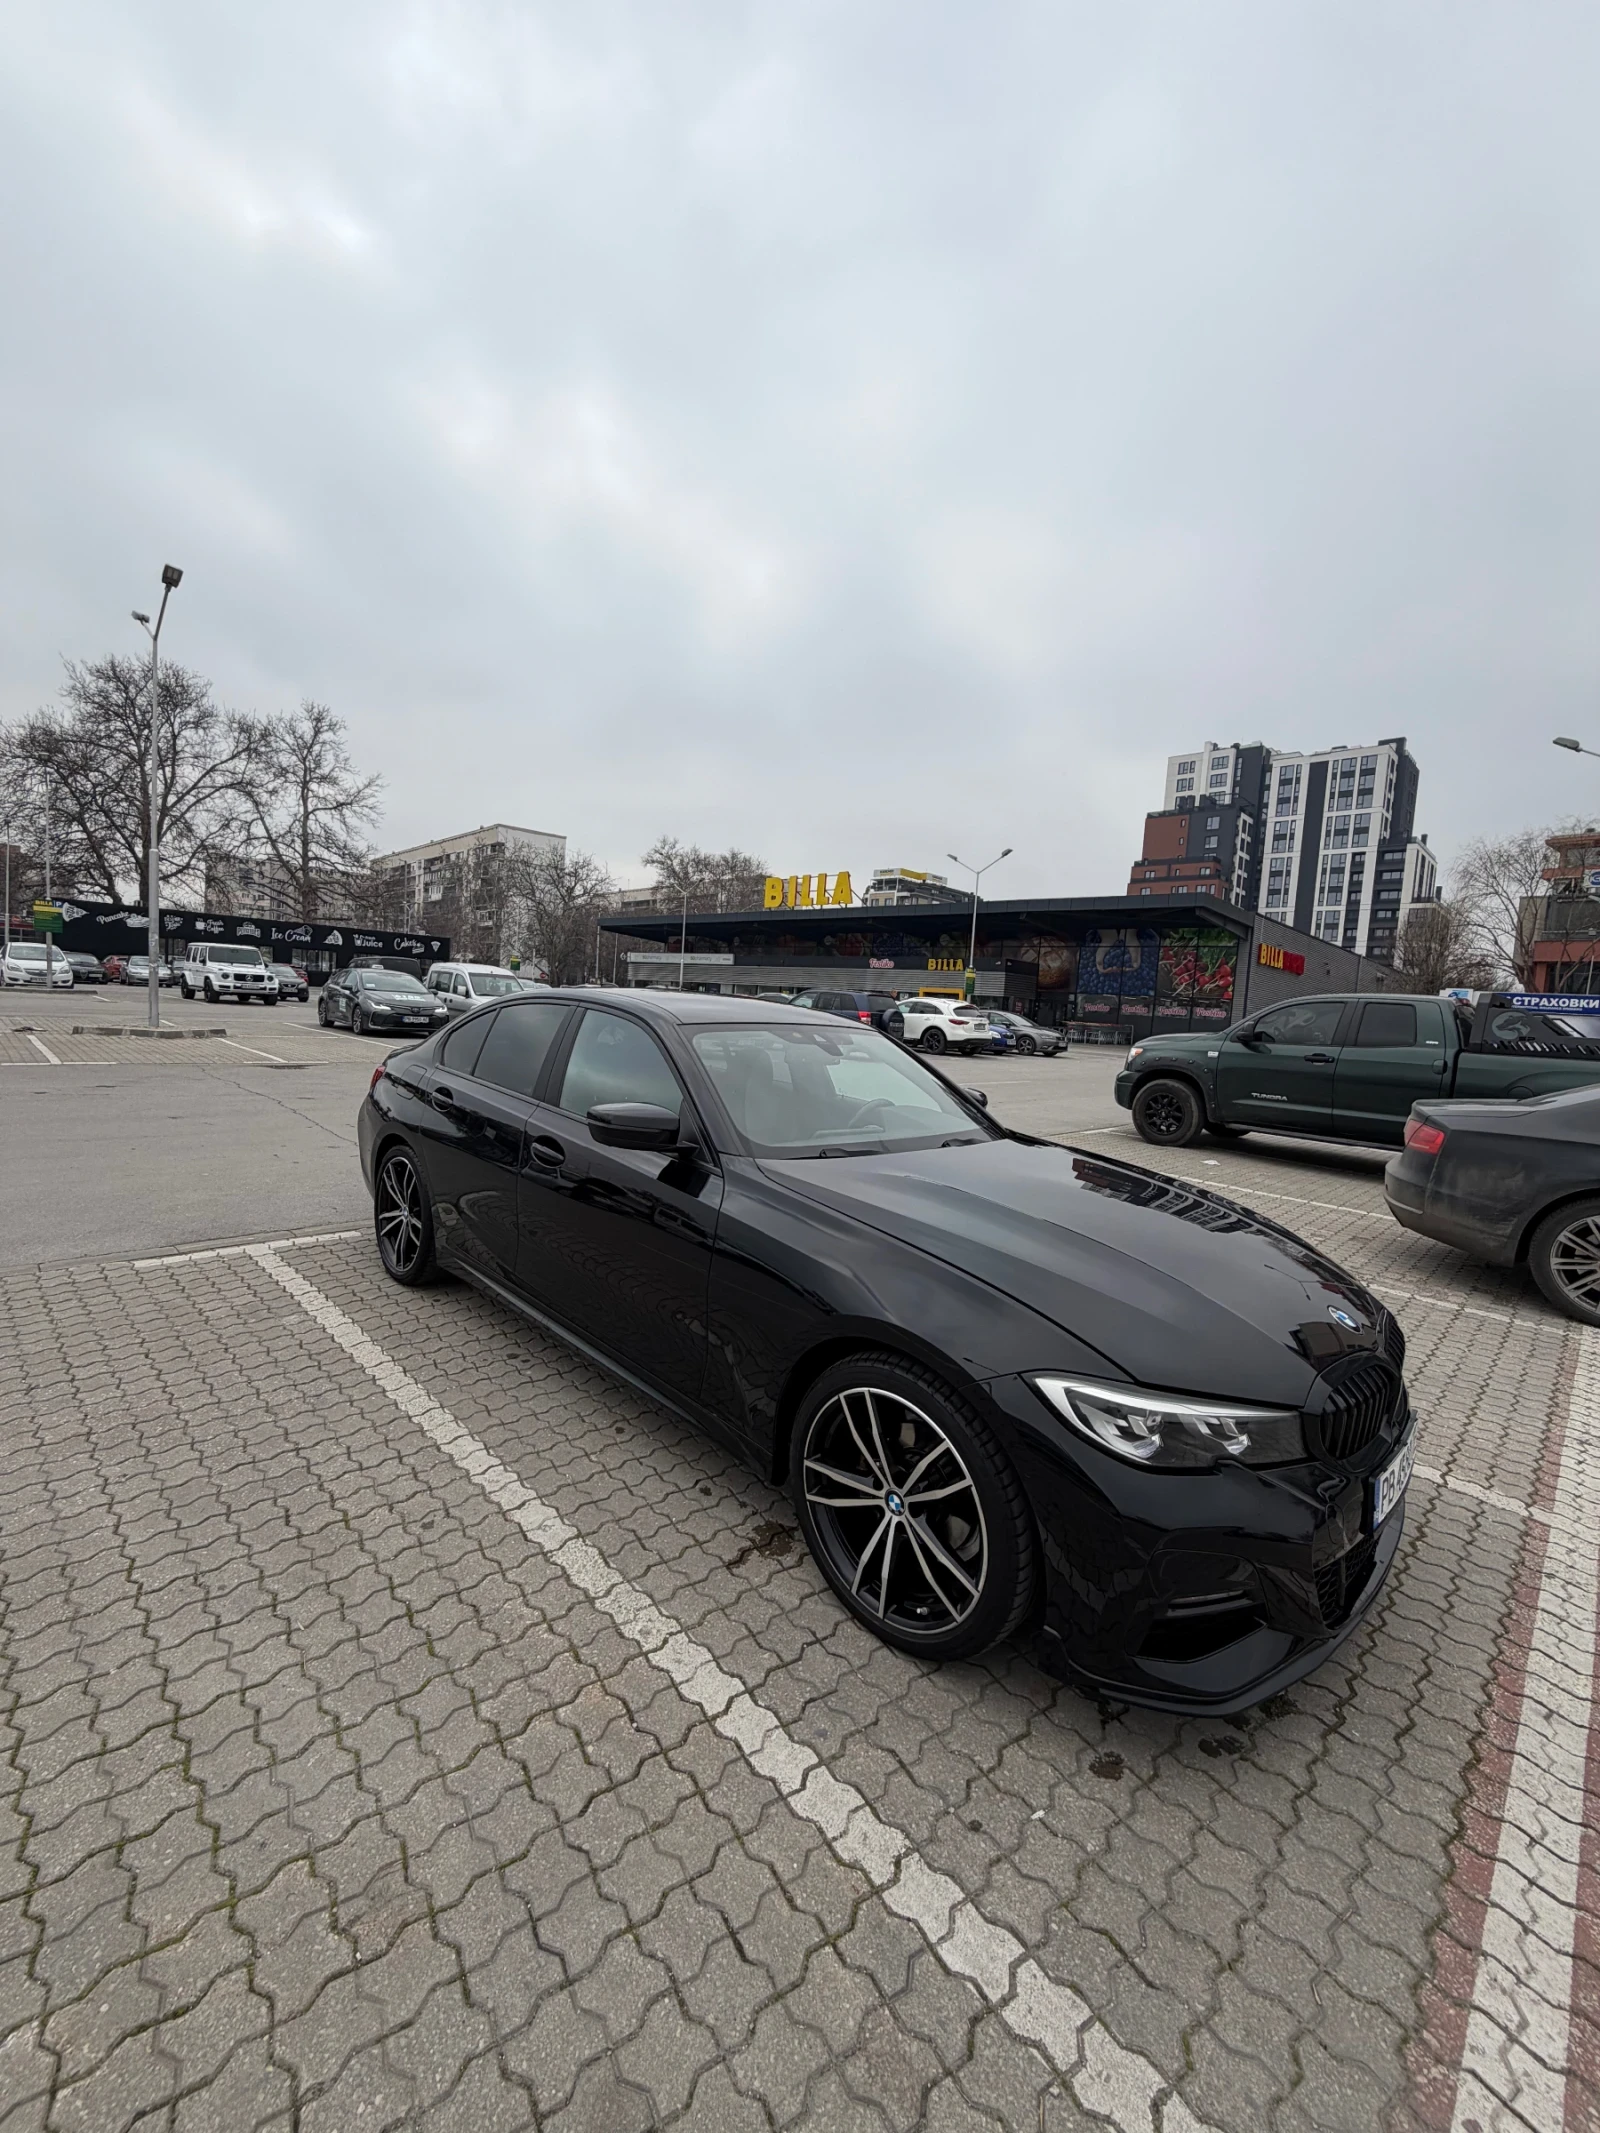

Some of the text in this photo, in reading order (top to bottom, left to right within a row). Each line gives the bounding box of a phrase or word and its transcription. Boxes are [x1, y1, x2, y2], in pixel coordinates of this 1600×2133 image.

[764, 871, 853, 909] BILLA
[270, 927, 312, 943] Ice Cream
[362, 939, 384, 948] Juice
[394, 938, 417, 950] Cakes
[1260, 943, 1284, 969] BILLA
[928, 958, 964, 972] BILLA
[1507, 996, 1600, 1009] СТРАХОВКИ
[1251, 1092, 1288, 1101] TUNDRA
[1382, 1469, 1395, 1514] PB
